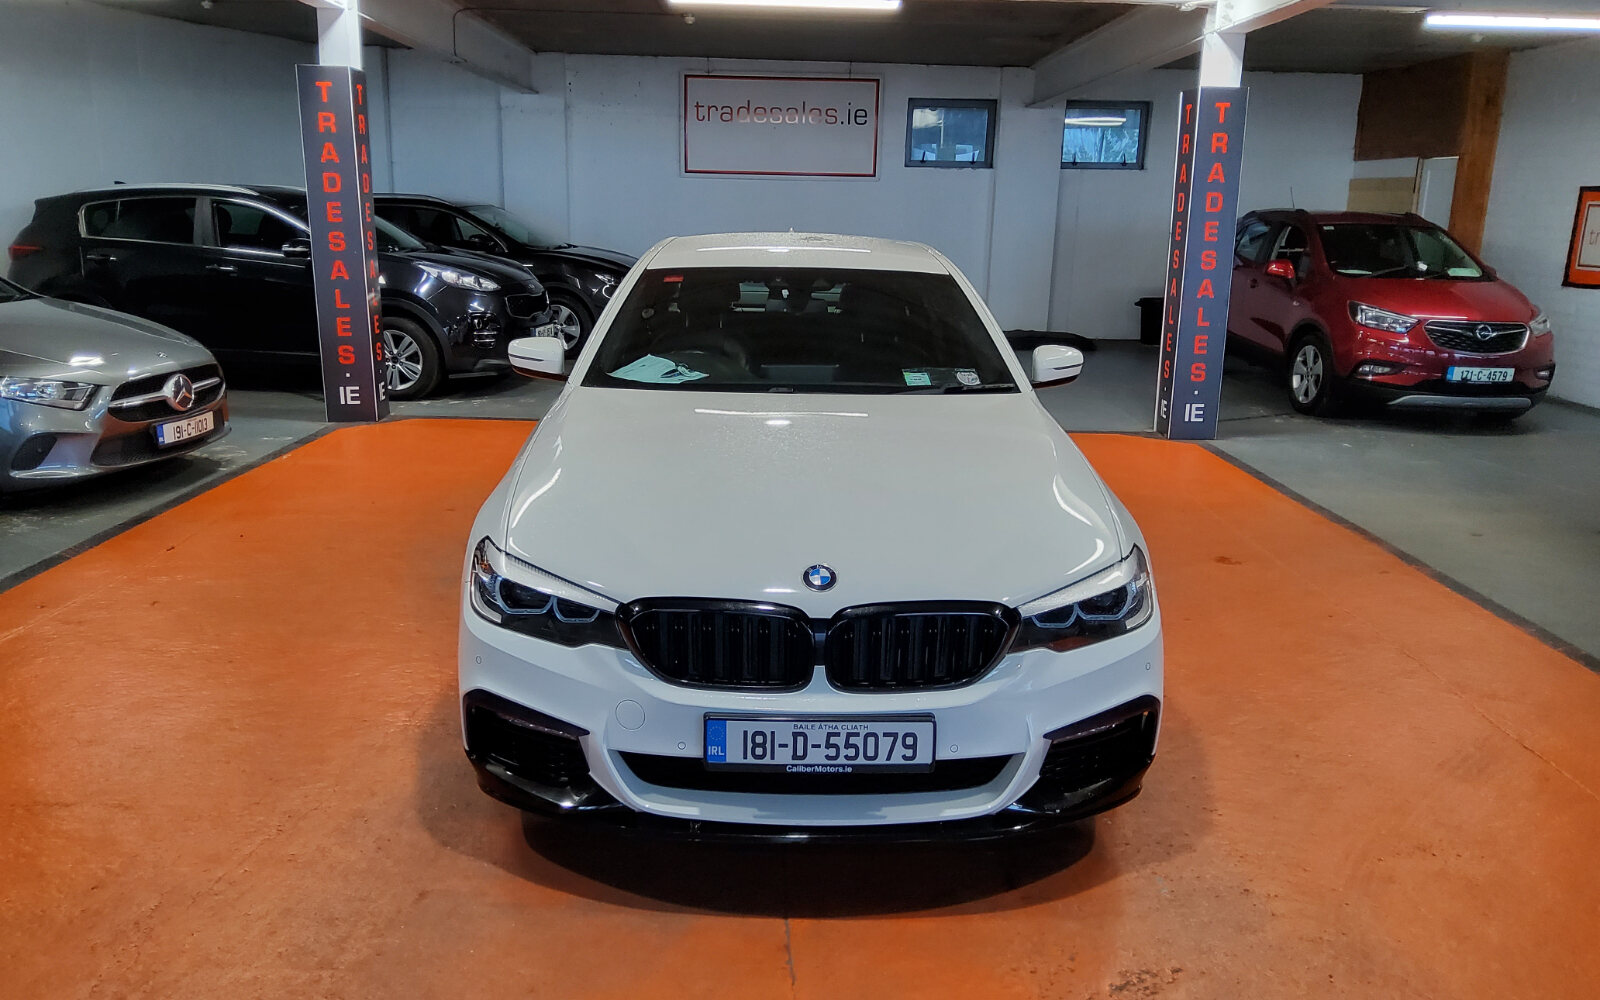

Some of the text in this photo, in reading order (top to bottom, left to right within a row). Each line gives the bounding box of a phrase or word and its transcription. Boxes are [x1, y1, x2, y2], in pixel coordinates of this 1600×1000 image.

[694, 100, 868, 125] tradesales.ie
[1460, 370, 1508, 381] 171-C-4579
[172, 417, 208, 441] 191-C-11013
[708, 746, 725, 756] IRL
[742, 730, 918, 762] 181-D-55079
[786, 764, 853, 773] CaliberMotors.ie
